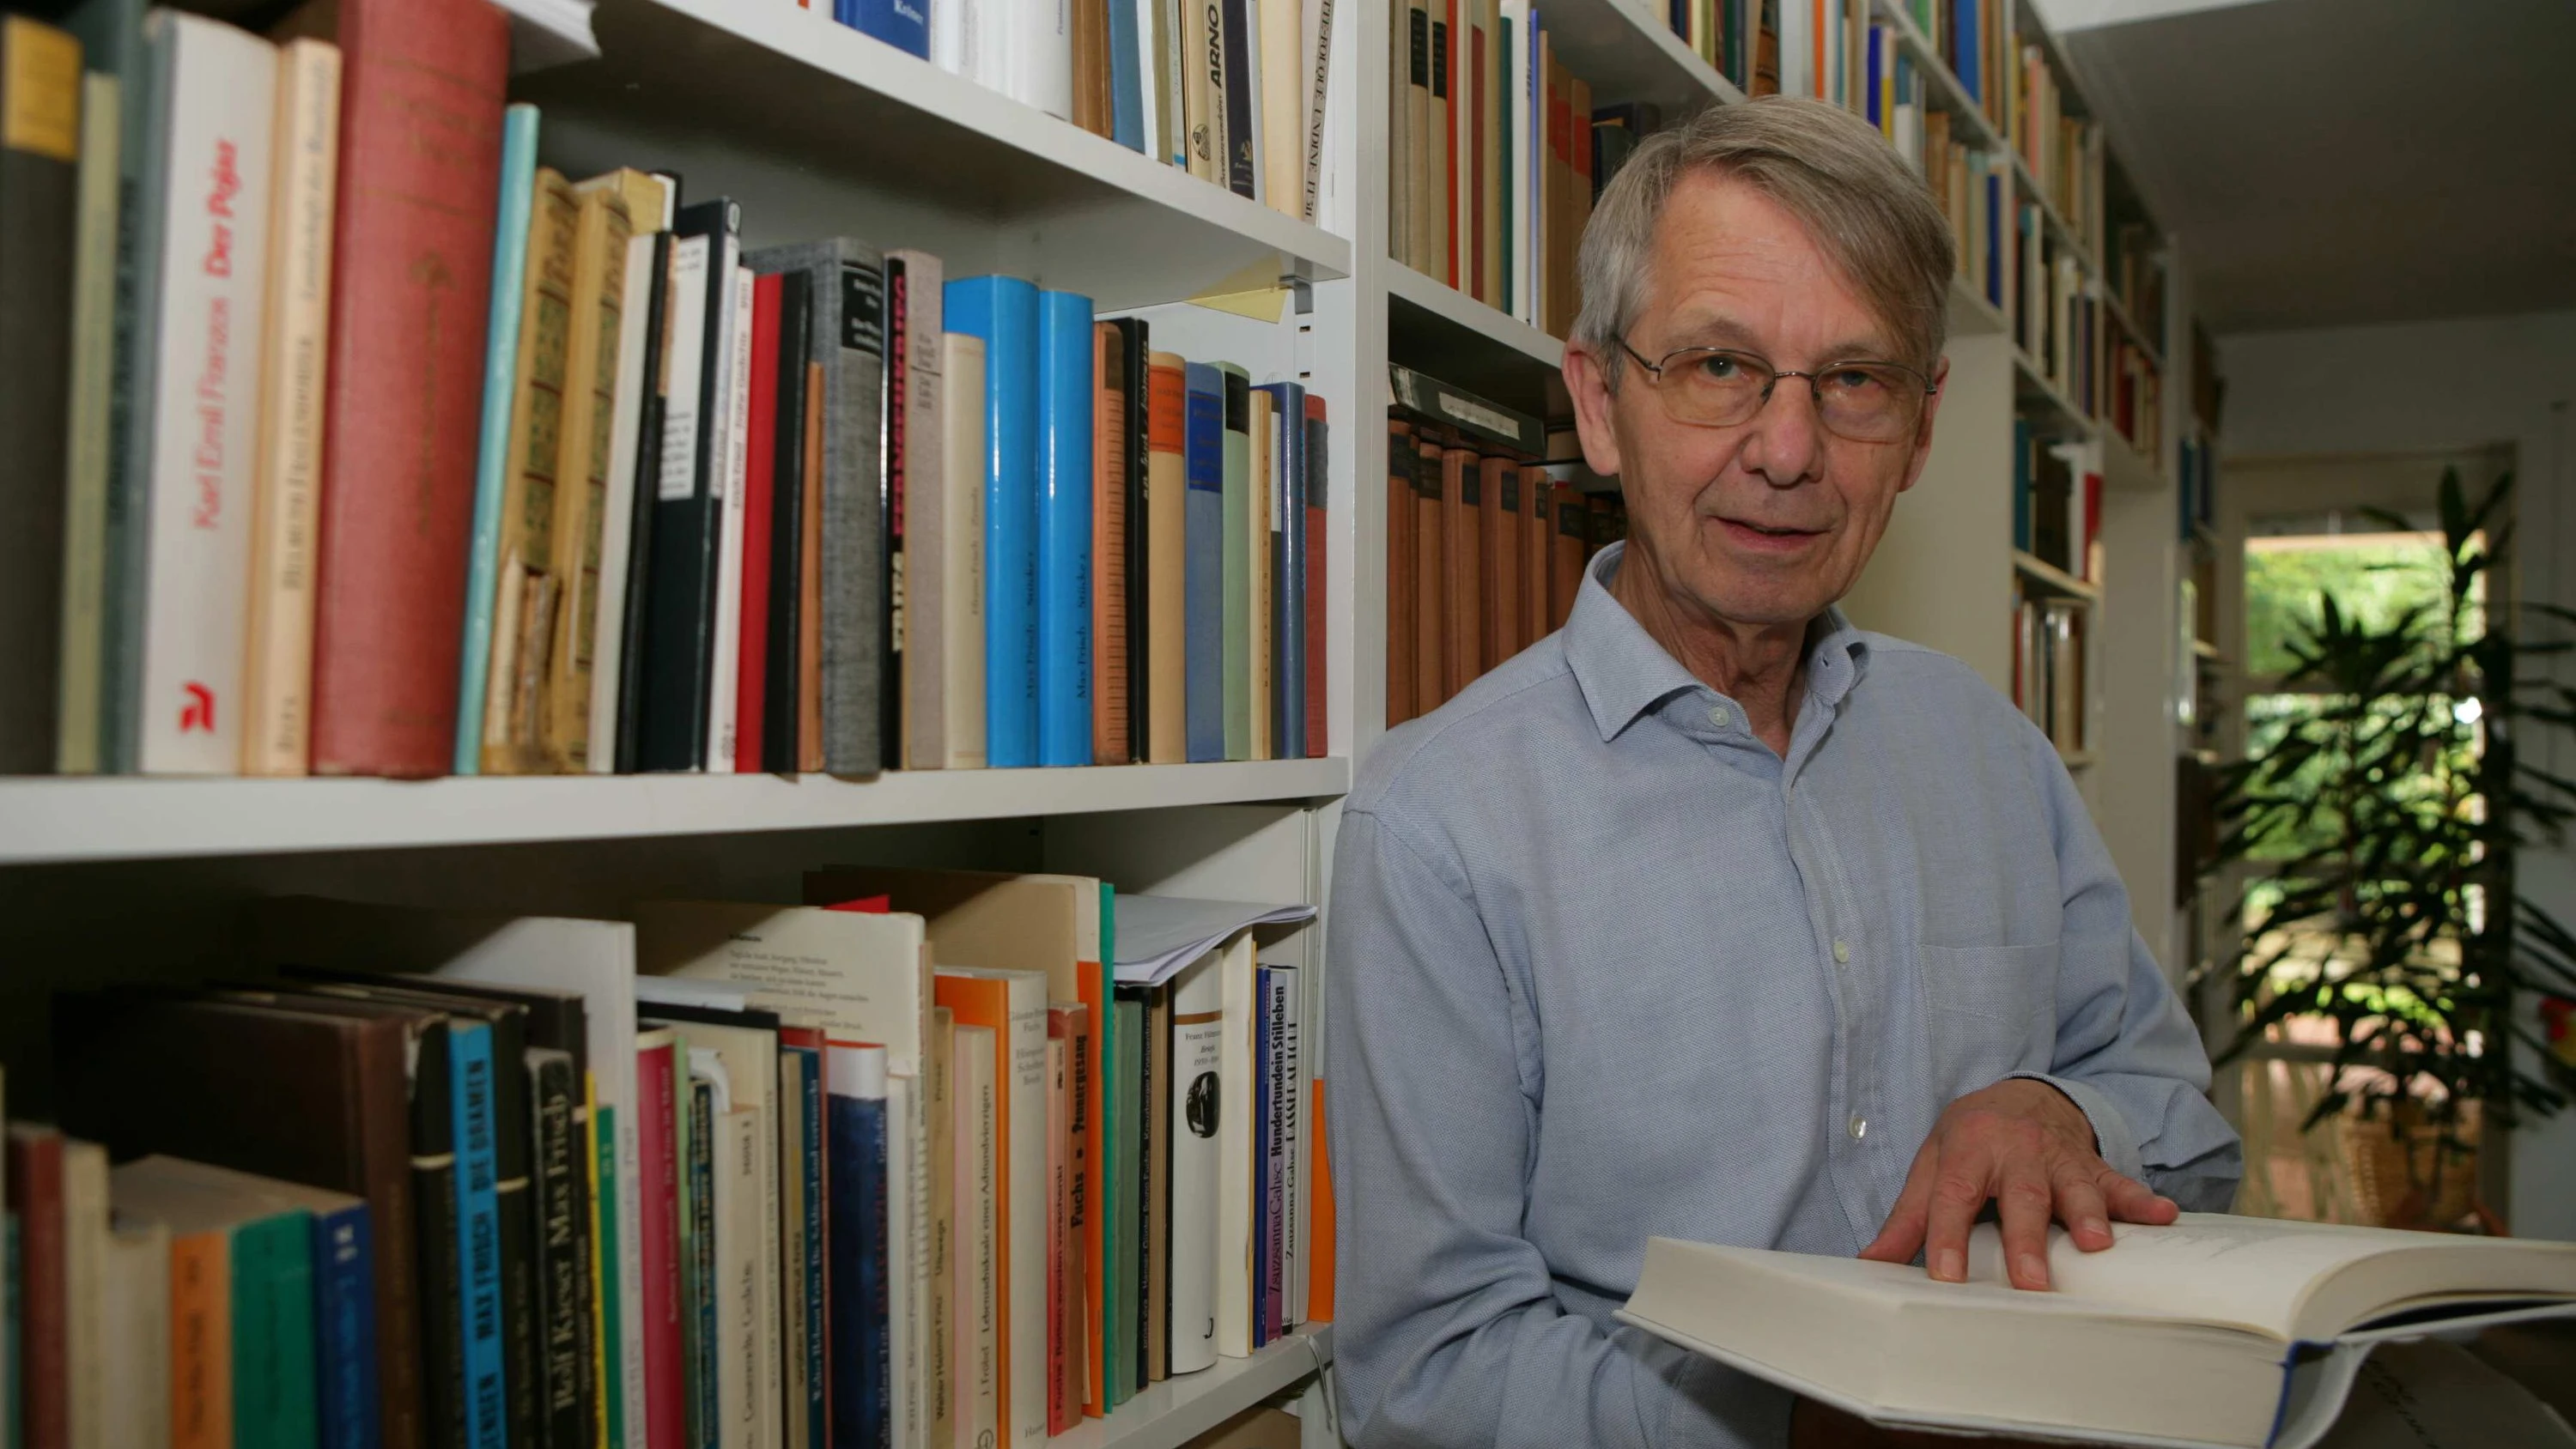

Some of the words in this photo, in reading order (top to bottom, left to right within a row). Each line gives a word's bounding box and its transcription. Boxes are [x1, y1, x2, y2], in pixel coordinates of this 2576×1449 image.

[1207, 4, 1223, 90] ARNO
[1309, 109, 1324, 174] UNDINE
[202, 223, 234, 278] Der
[1074, 625, 1088, 664] Frisch
[1076, 668, 1088, 699] Max
[1271, 985, 1285, 1049] Stilleben
[465, 1058, 489, 1153] DRAMEN
[1070, 1034, 1088, 1135] Pennergesang
[1270, 1052, 1285, 1157] Hundertundein
[541, 1093, 570, 1177] Frisch
[469, 1161, 490, 1194] DIE
[1268, 1162, 1283, 1215] Gahse
[1286, 1149, 1297, 1189] Gahse
[544, 1182, 573, 1248] Max
[981, 1198, 990, 1230] eines
[1070, 1171, 1085, 1229] Fuchs
[1285, 1192, 1297, 1260] Zsuzsanna
[471, 1211, 494, 1288] FRISCH
[1268, 1215, 1284, 1295] Zsuzsanna
[475, 1293, 495, 1341] MAX
[934, 1295, 944, 1326] Fritz
[549, 1350, 576, 1411] Rolf
[933, 1327, 944, 1376] Helmut
[934, 1379, 945, 1421] Walter
